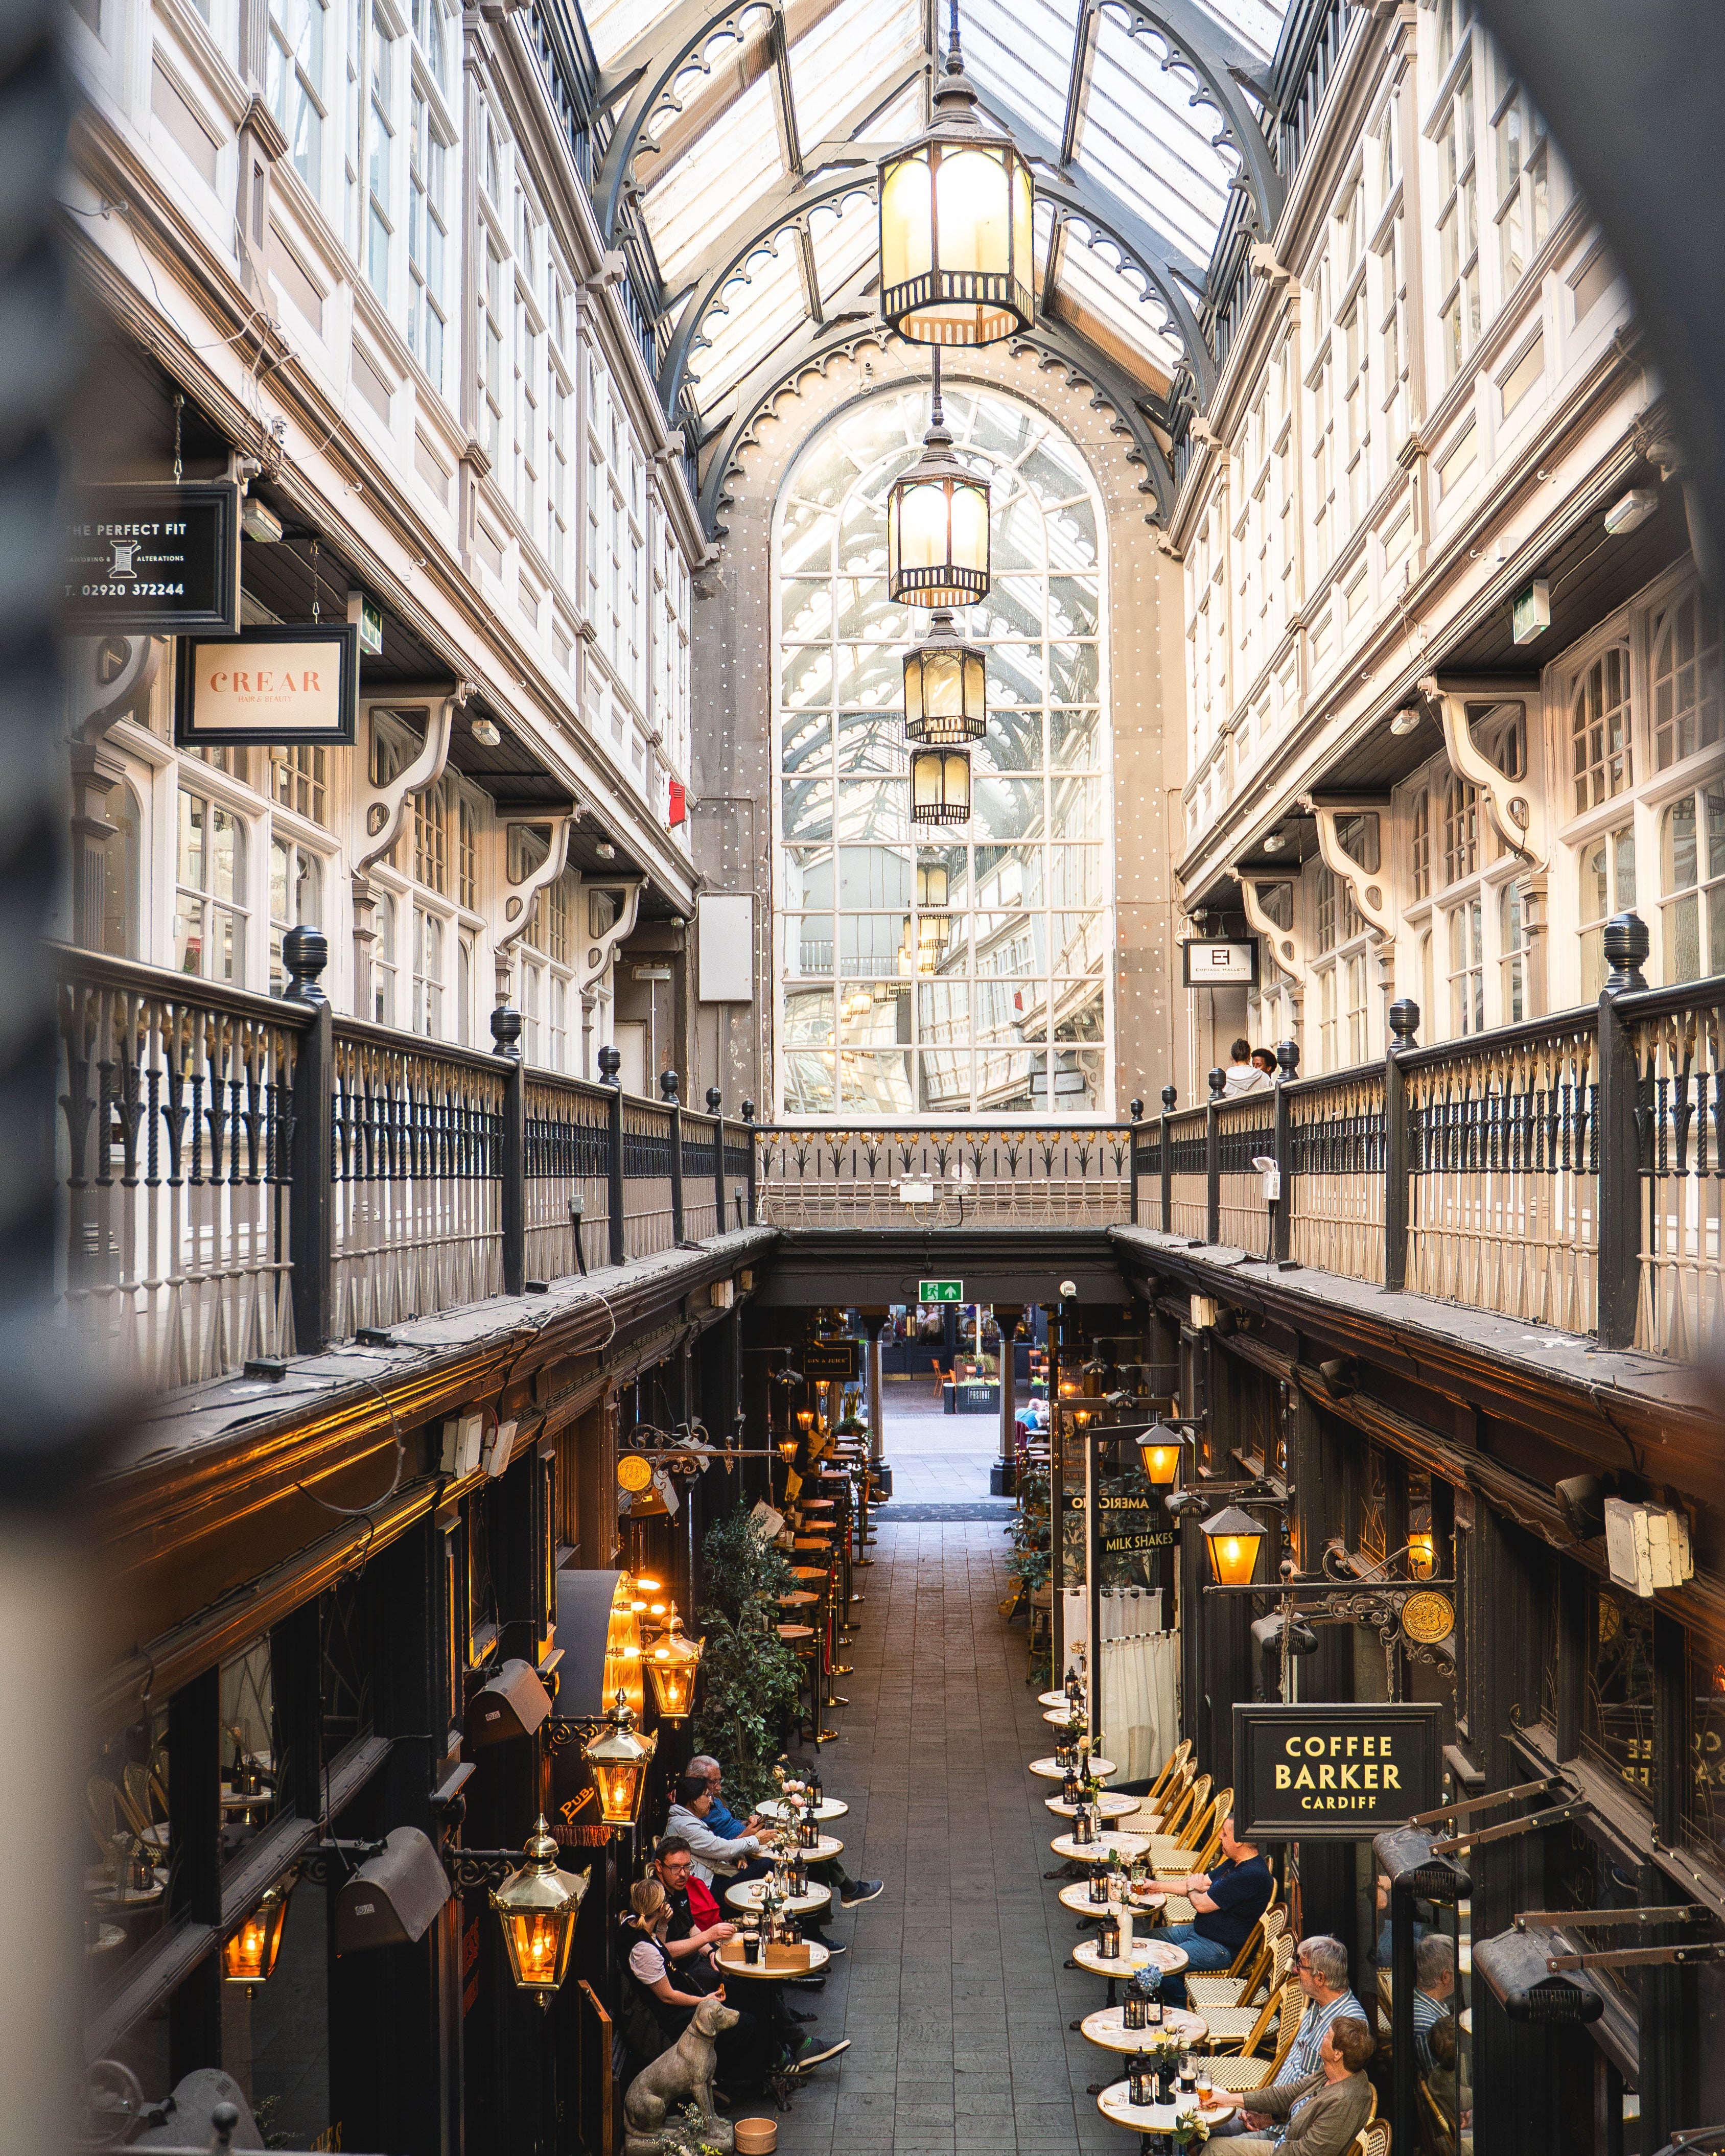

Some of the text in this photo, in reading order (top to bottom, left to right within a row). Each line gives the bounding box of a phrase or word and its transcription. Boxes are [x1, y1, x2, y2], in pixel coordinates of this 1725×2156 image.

[98, 524, 159, 535] PERFECT
[166, 524, 187, 535] FIT
[82, 584, 126, 596] 02920
[132, 583, 184, 595] 372244
[210, 671, 321, 692] CREAR
[1106, 1532, 1173, 1552] MILK SHAKES
[1286, 1736, 1392, 1757] COFFEE
[1275, 1764, 1402, 1789] BARKER
[560, 1788, 591, 1817] PUB
[1301, 1796, 1377, 1809] CARDIFF
